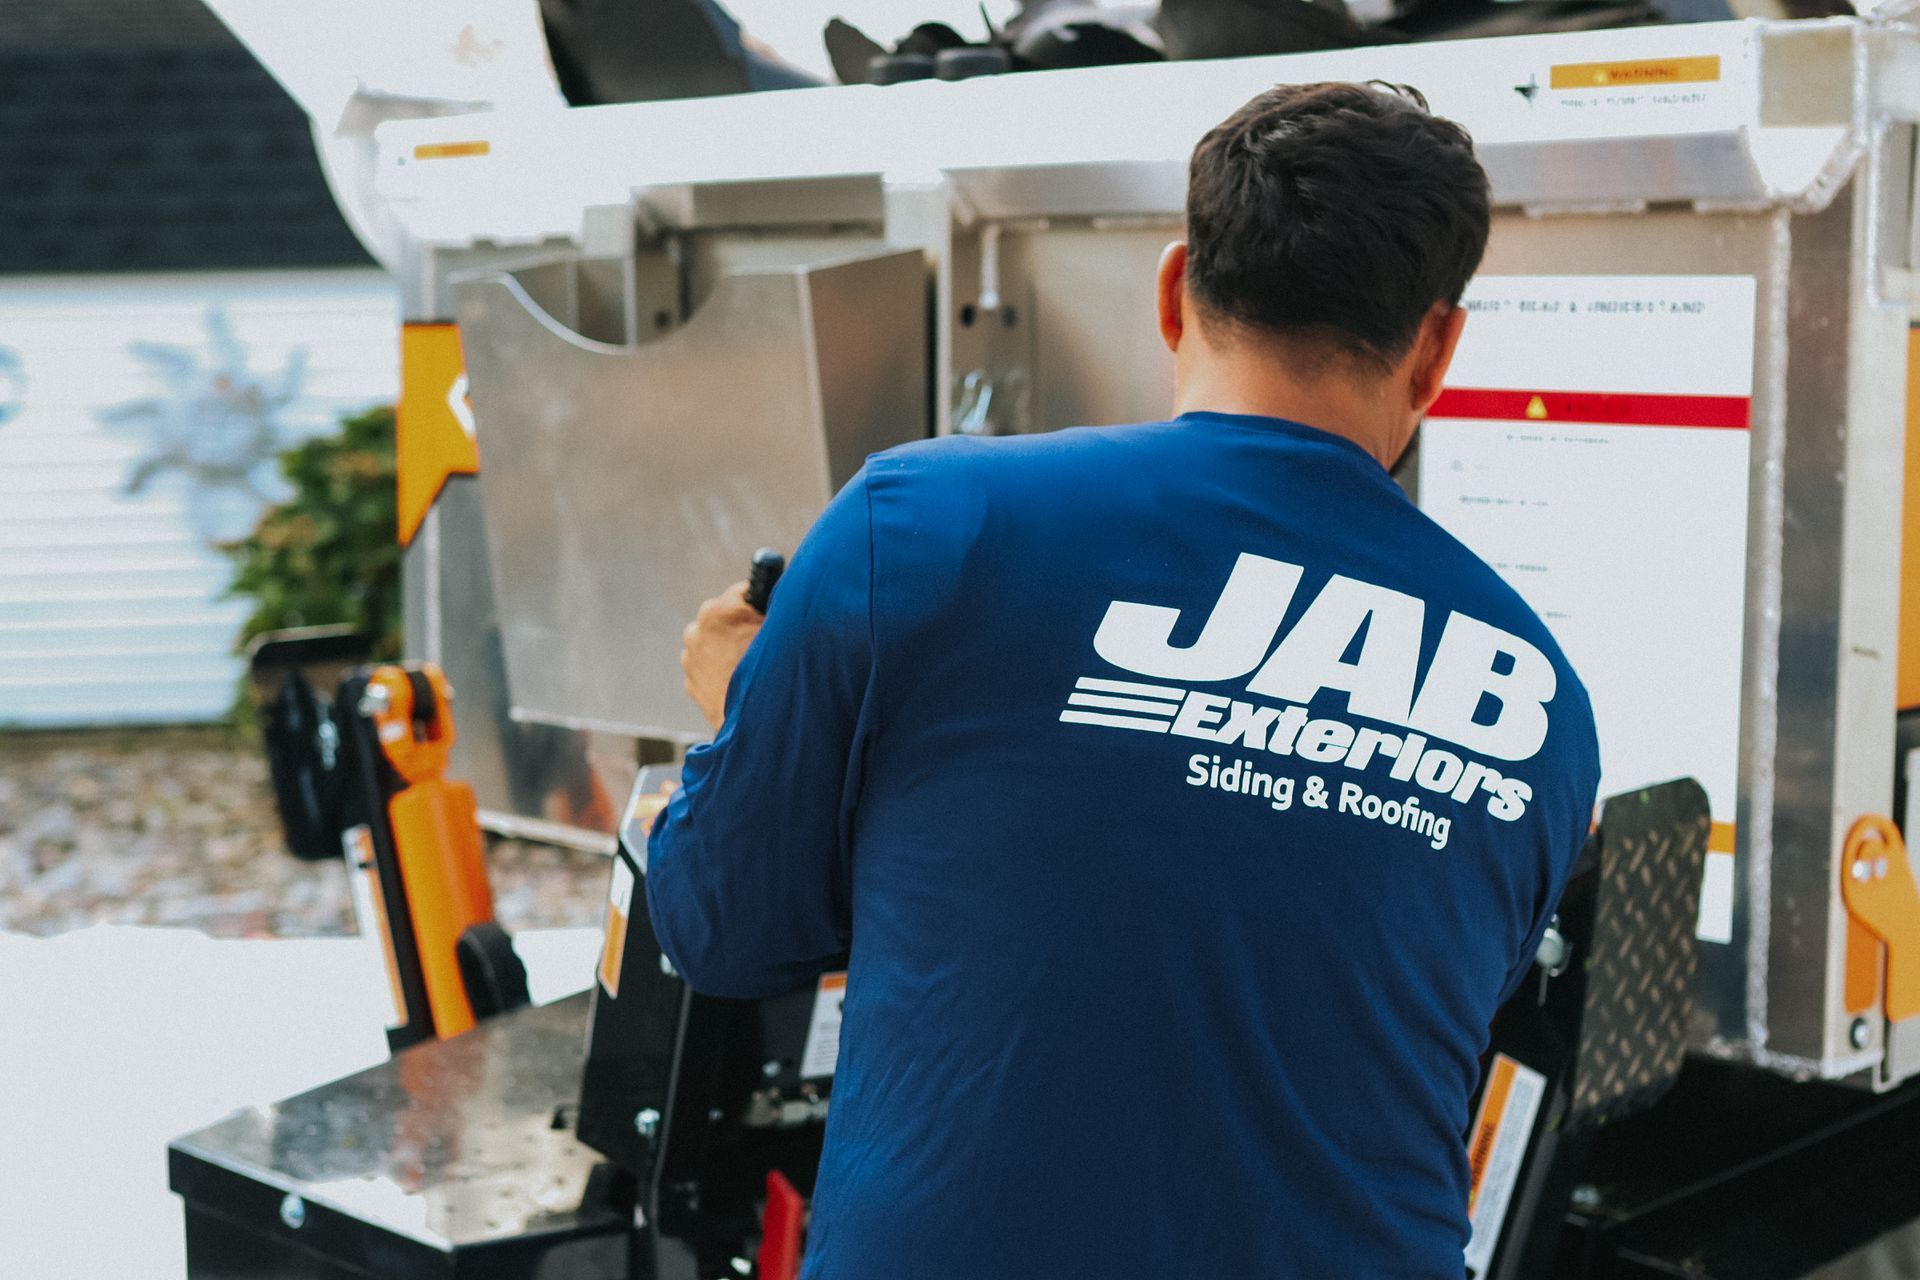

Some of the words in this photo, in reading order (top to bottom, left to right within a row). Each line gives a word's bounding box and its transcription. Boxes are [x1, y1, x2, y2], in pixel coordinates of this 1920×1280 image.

[1094, 552, 1557, 762] JAB
[1170, 690, 1533, 822] Exteriors
[1186, 754, 1295, 811] Siding
[1302, 775, 1329, 810] &
[1338, 781, 1452, 850] Roofing
